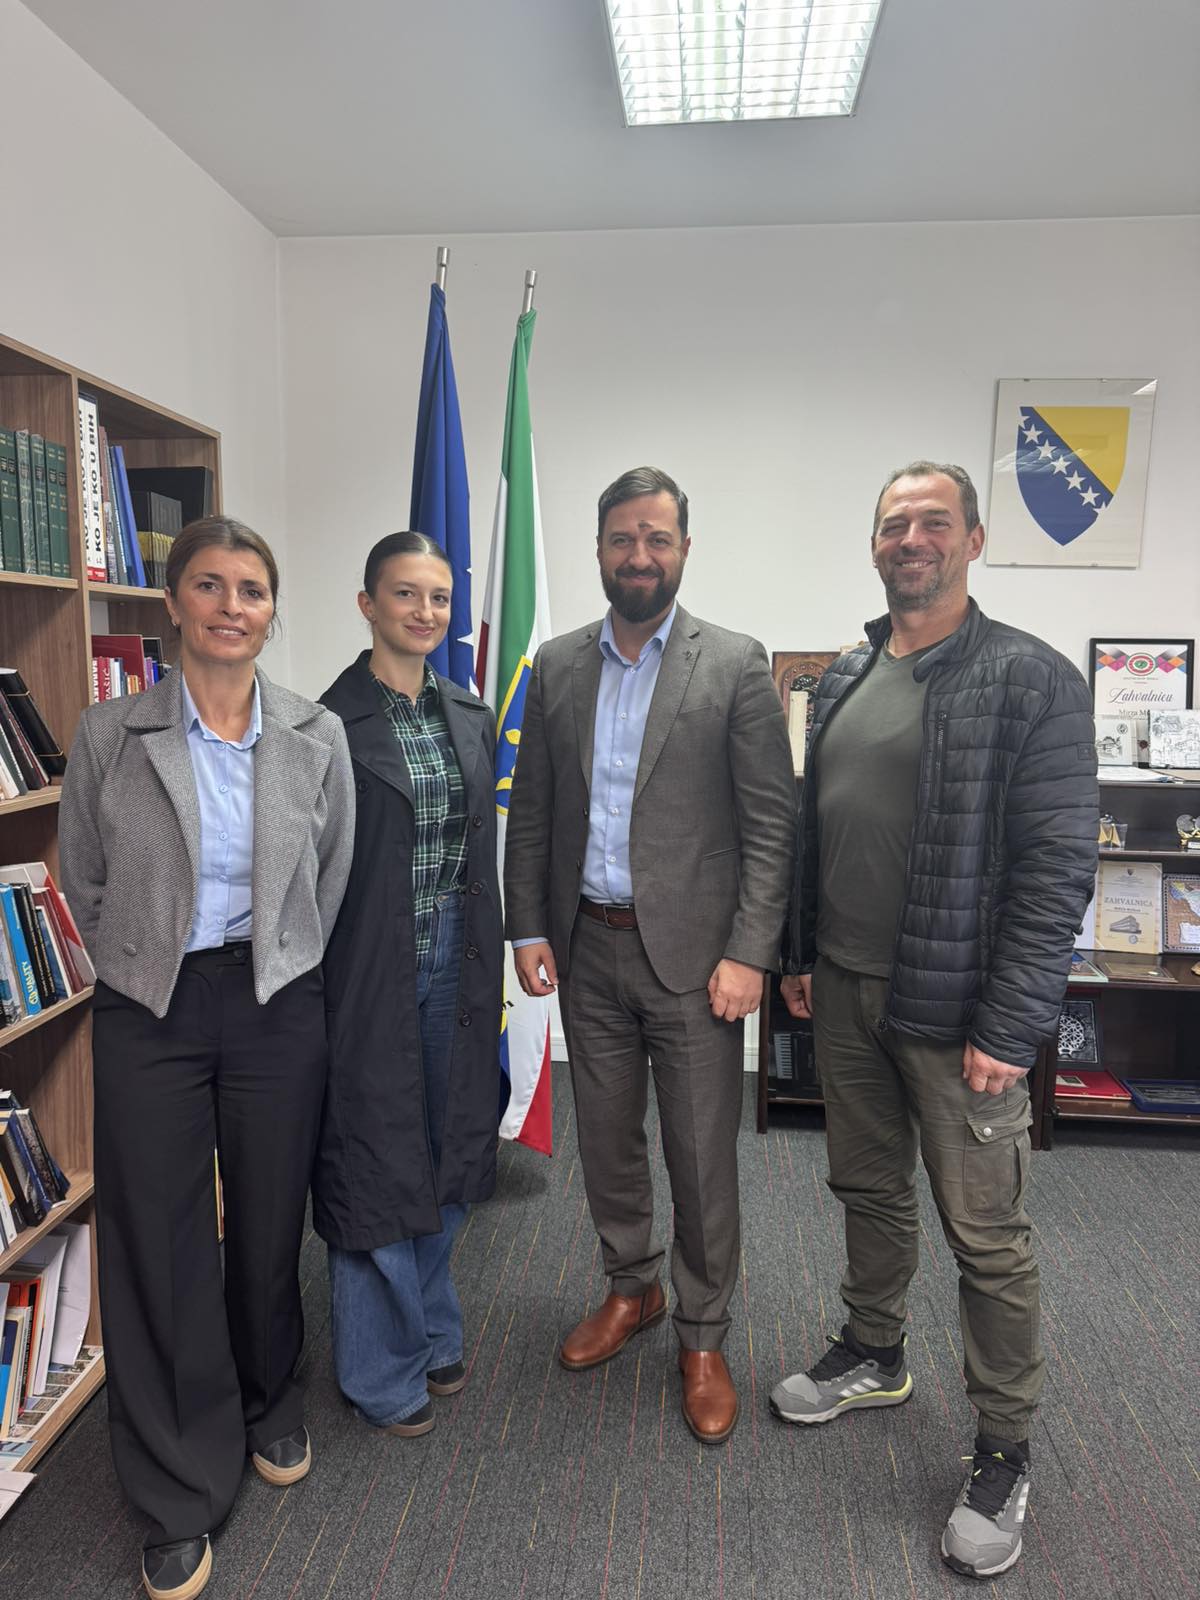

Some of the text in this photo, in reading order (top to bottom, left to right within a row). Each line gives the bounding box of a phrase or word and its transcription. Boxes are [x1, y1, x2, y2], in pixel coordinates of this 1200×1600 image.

[90, 452, 96, 463] U
[91, 470, 98, 495] KO
[93, 501, 99, 522] JE
[94, 527, 101, 552] KO
[1107, 688, 1173, 704] Zahvalnica
[1104, 896, 1153, 907] ZAHVALNICA
[22, 961, 38, 1005] QUALITY
